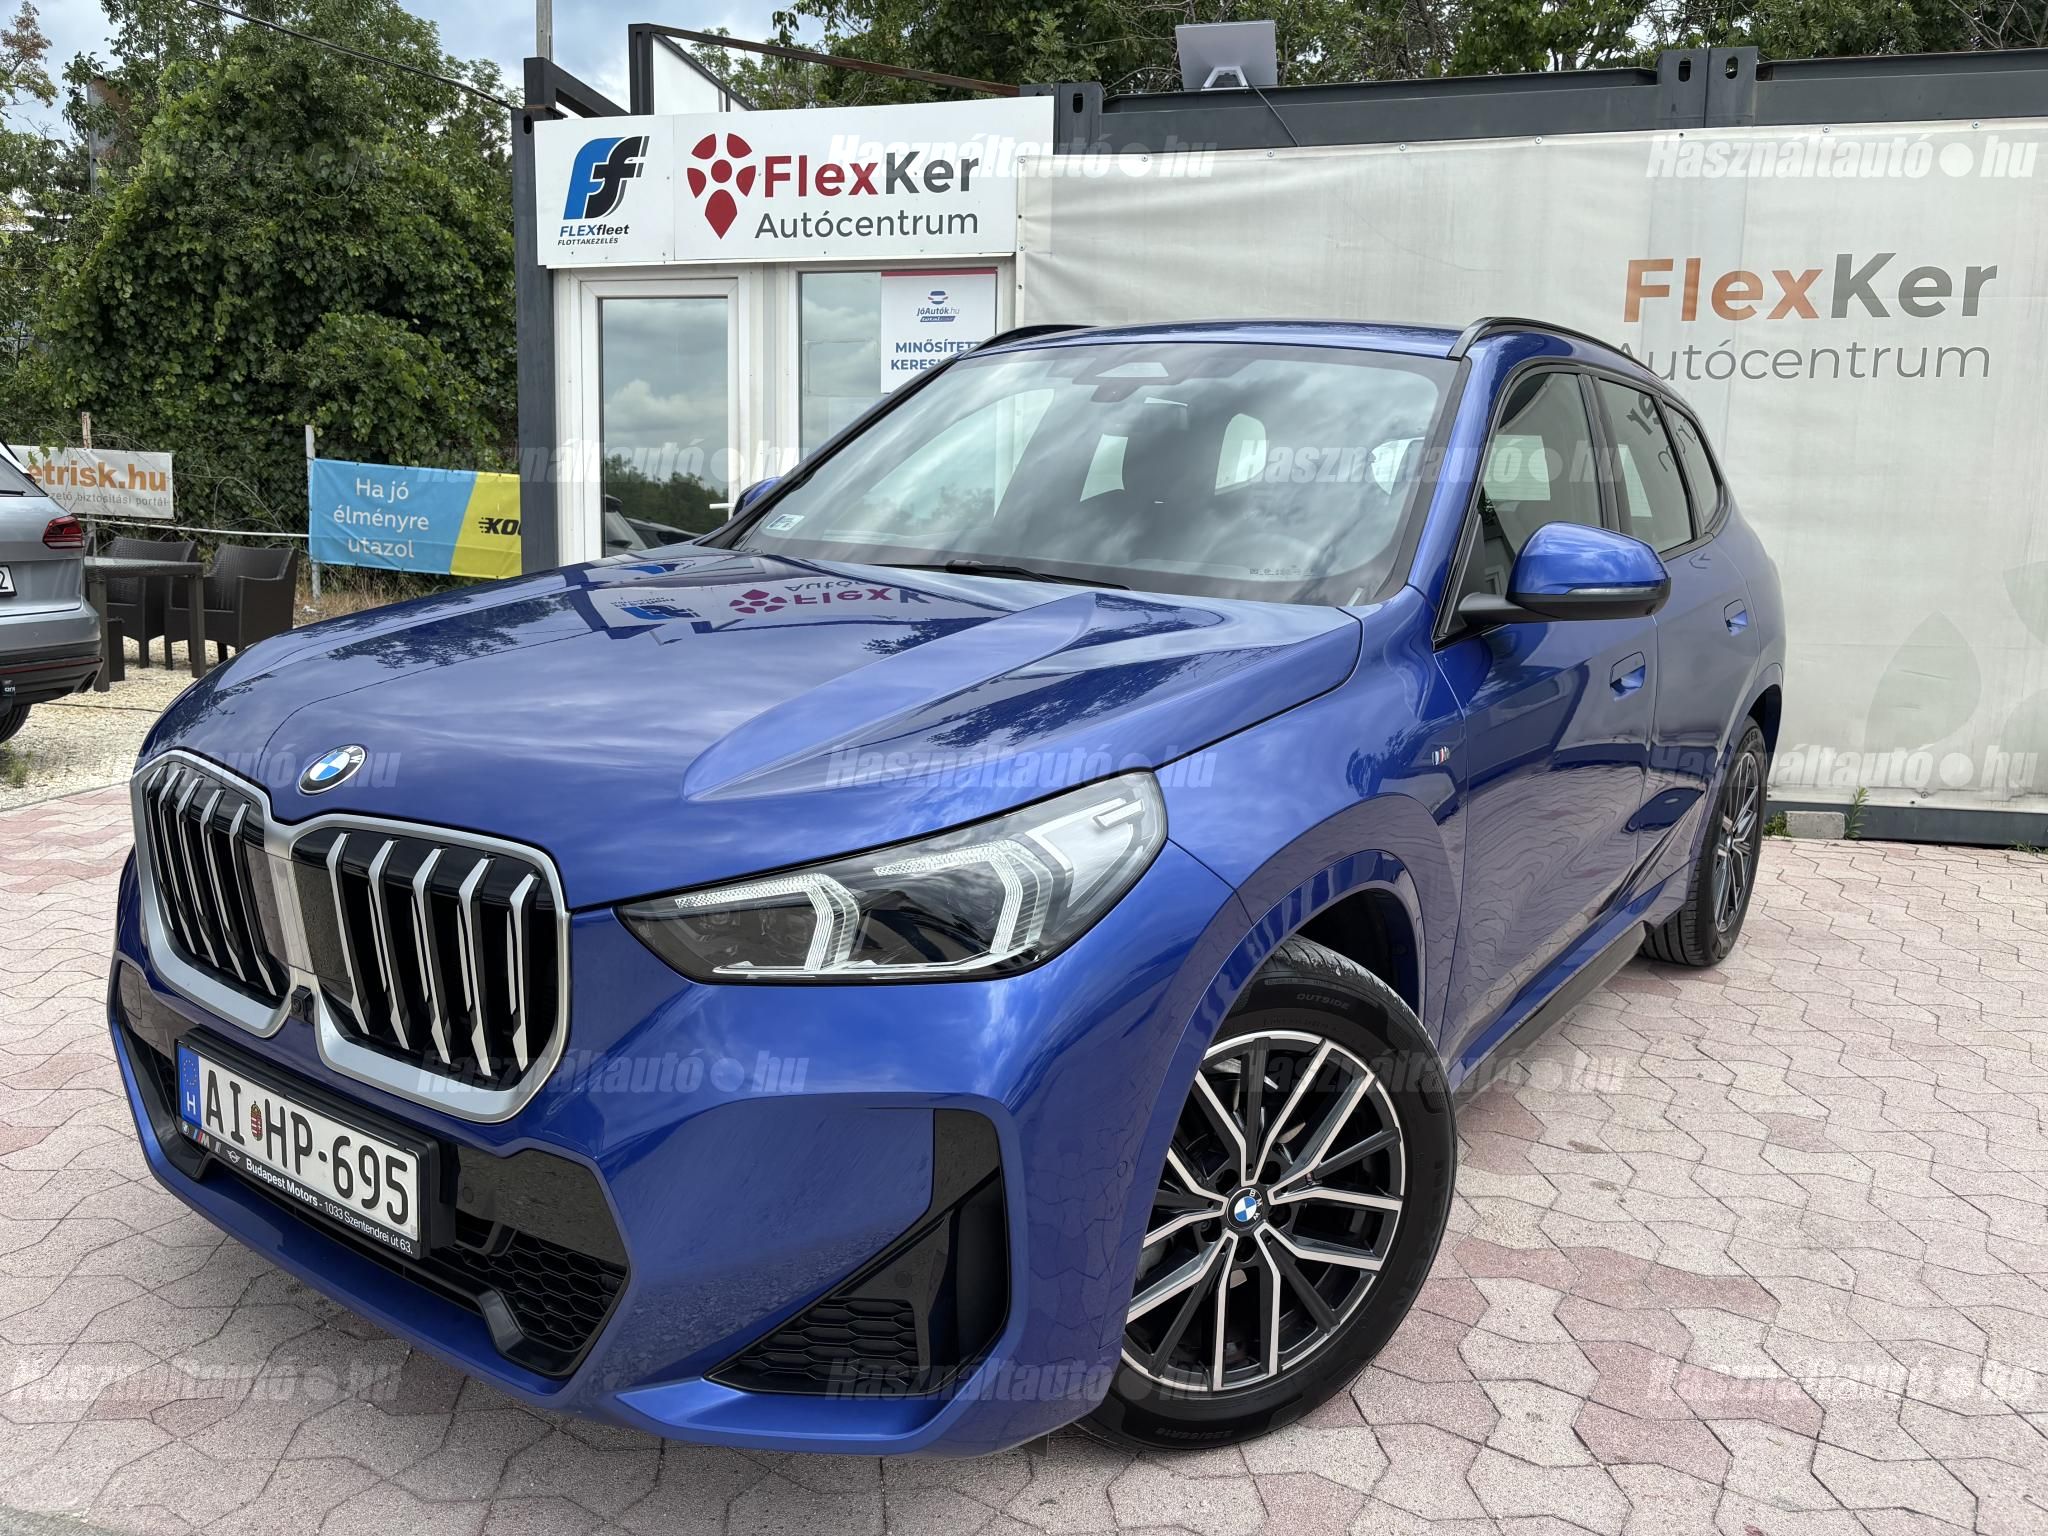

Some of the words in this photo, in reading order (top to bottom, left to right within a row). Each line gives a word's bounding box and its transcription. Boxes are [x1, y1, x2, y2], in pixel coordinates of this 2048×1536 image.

[765, 151, 979, 198] FlexKer
[560, 224, 630, 238] FLEXfleet
[754, 210, 978, 238] Autócentrum
[1624, 253, 1998, 323] FlexKer
[891, 359, 941, 370] KERES
[356, 478, 384, 498] Ha
[388, 481, 409, 503] jó
[333, 504, 429, 533] élményre
[348, 537, 414, 558] utazol
[186, 1092, 197, 1116] H
[246, 1158, 286, 1189] Budapest
[287, 1179, 318, 1206] Motors
[324, 1201, 343, 1220] 1033
[344, 1211, 389, 1243] Szentendrei
[390, 1234, 400, 1248] út
[400, 1240, 413, 1254] 63.
